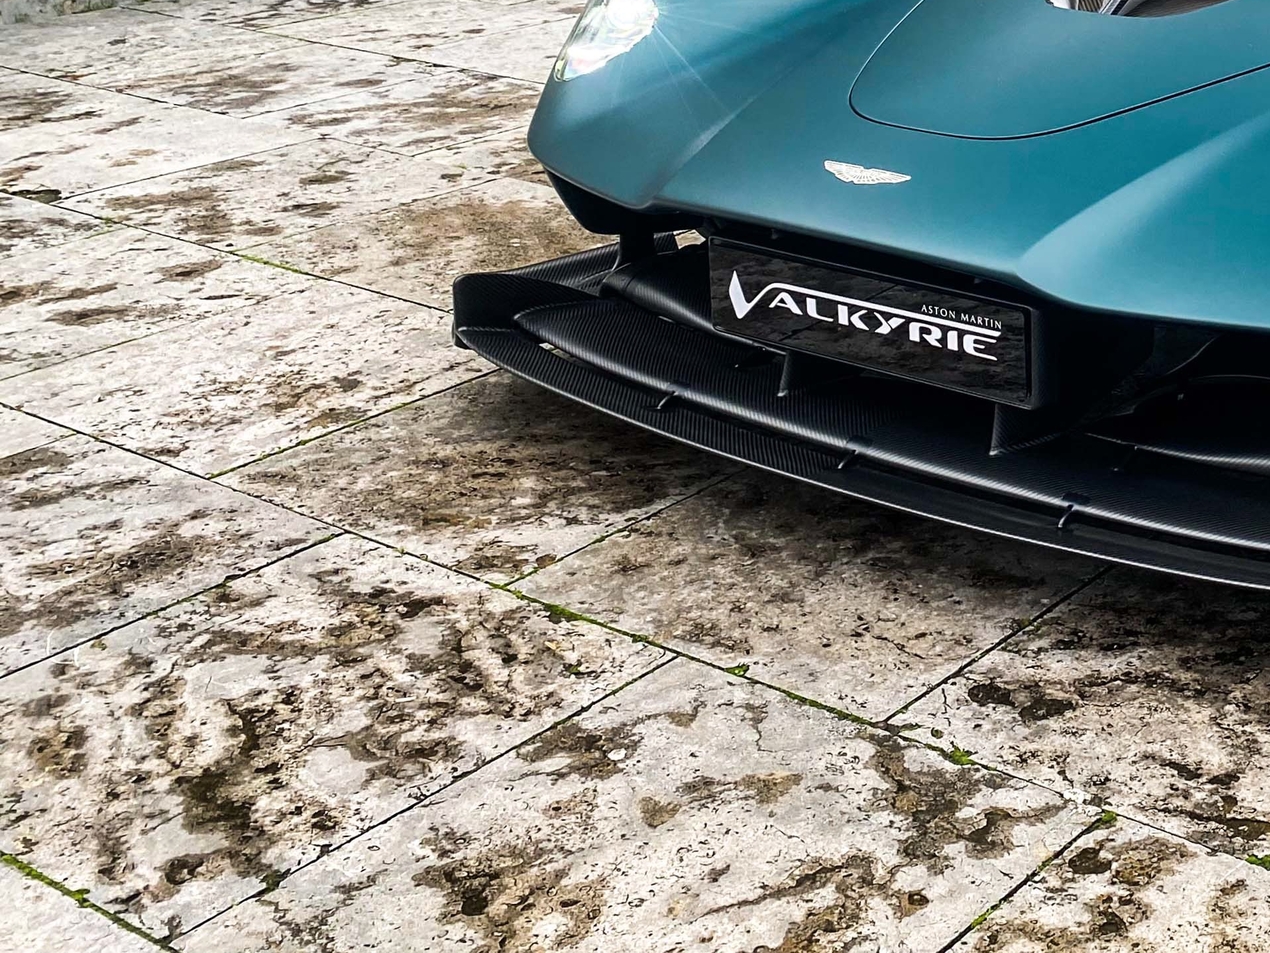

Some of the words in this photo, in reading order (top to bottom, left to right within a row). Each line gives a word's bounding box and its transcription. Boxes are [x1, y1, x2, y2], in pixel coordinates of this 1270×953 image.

[728, 270, 1002, 361] VALKYRIE
[921, 304, 956, 319] ASTON
[960, 312, 1002, 329] MARTIN
